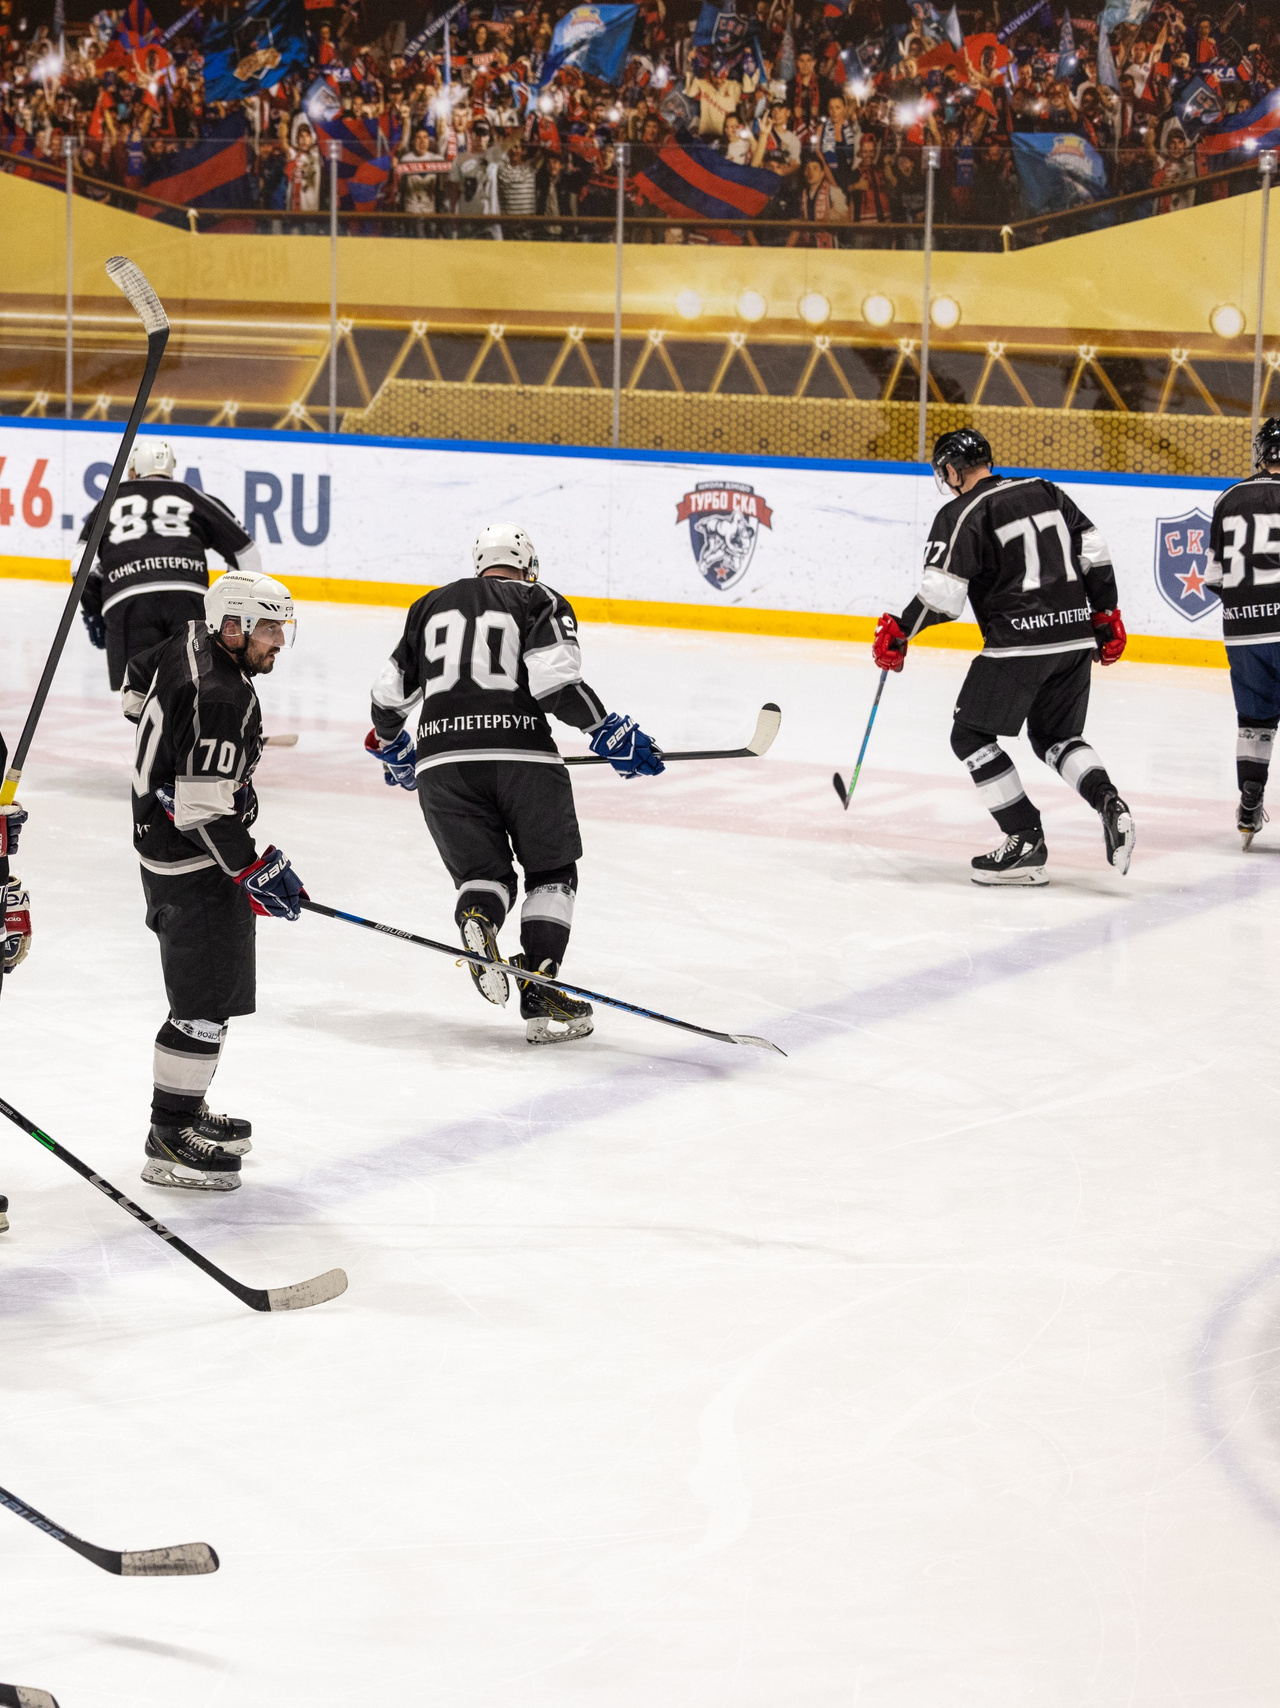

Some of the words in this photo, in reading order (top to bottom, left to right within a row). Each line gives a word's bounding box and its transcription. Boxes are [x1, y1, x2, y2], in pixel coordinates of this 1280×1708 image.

[108, 494, 195, 545] 88
[689, 491, 729, 512] ТУРБО
[732, 492, 757, 516] СКА
[923, 540, 948, 567] 77
[994, 508, 1079, 593] 77
[1165, 528, 1207, 557] СК
[1222, 513, 1280, 589] 35
[108, 556, 206, 584] САНКТ-ПЕТЕРБУРГ
[560, 615, 578, 637] 9
[424, 608, 521, 701] 90
[131, 694, 165, 799] 0
[606, 716, 637, 751] BAU
[199, 738, 238, 775] 70
[257, 853, 290, 888] BAU
[374, 922, 414, 940] BAUER
[176, 1148, 198, 1162] CCM
